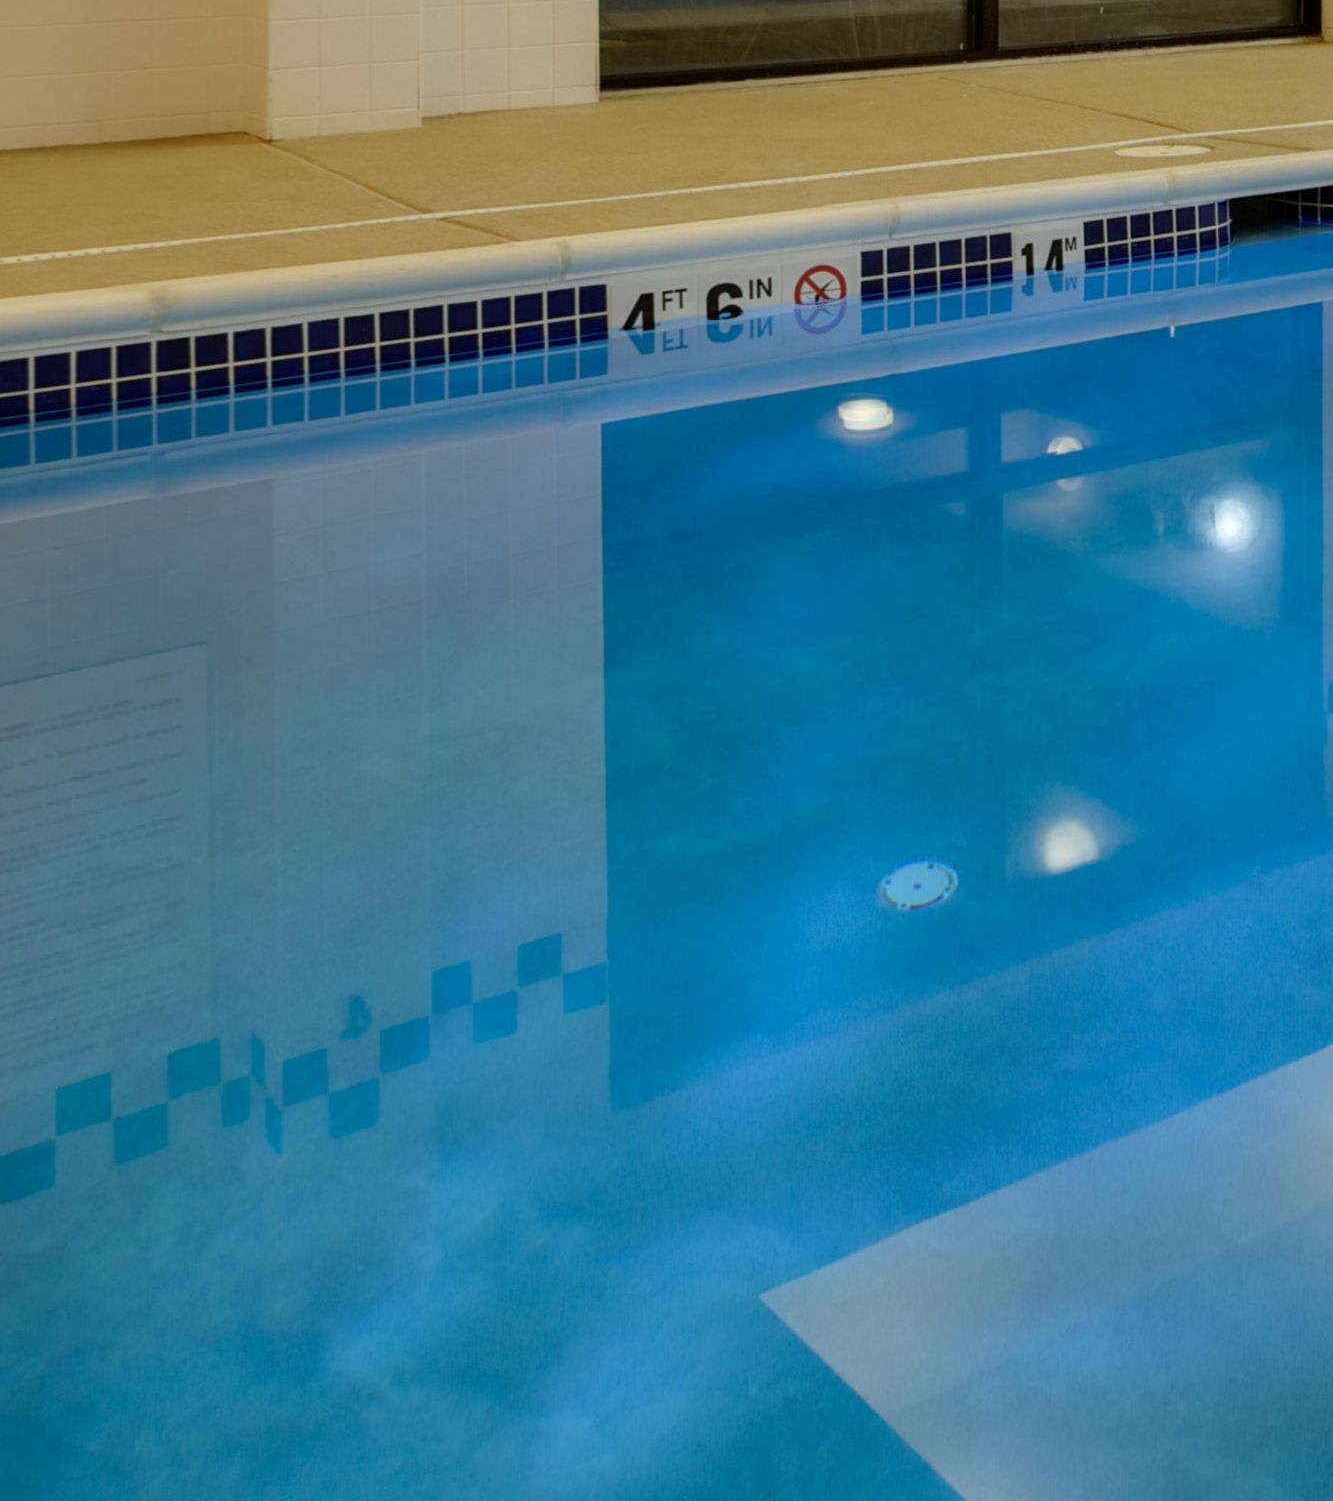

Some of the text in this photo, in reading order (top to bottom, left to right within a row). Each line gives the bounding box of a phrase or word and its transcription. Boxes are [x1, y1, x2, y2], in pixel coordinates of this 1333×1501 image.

[621, 277, 773, 331] 4 FT 6 IN
